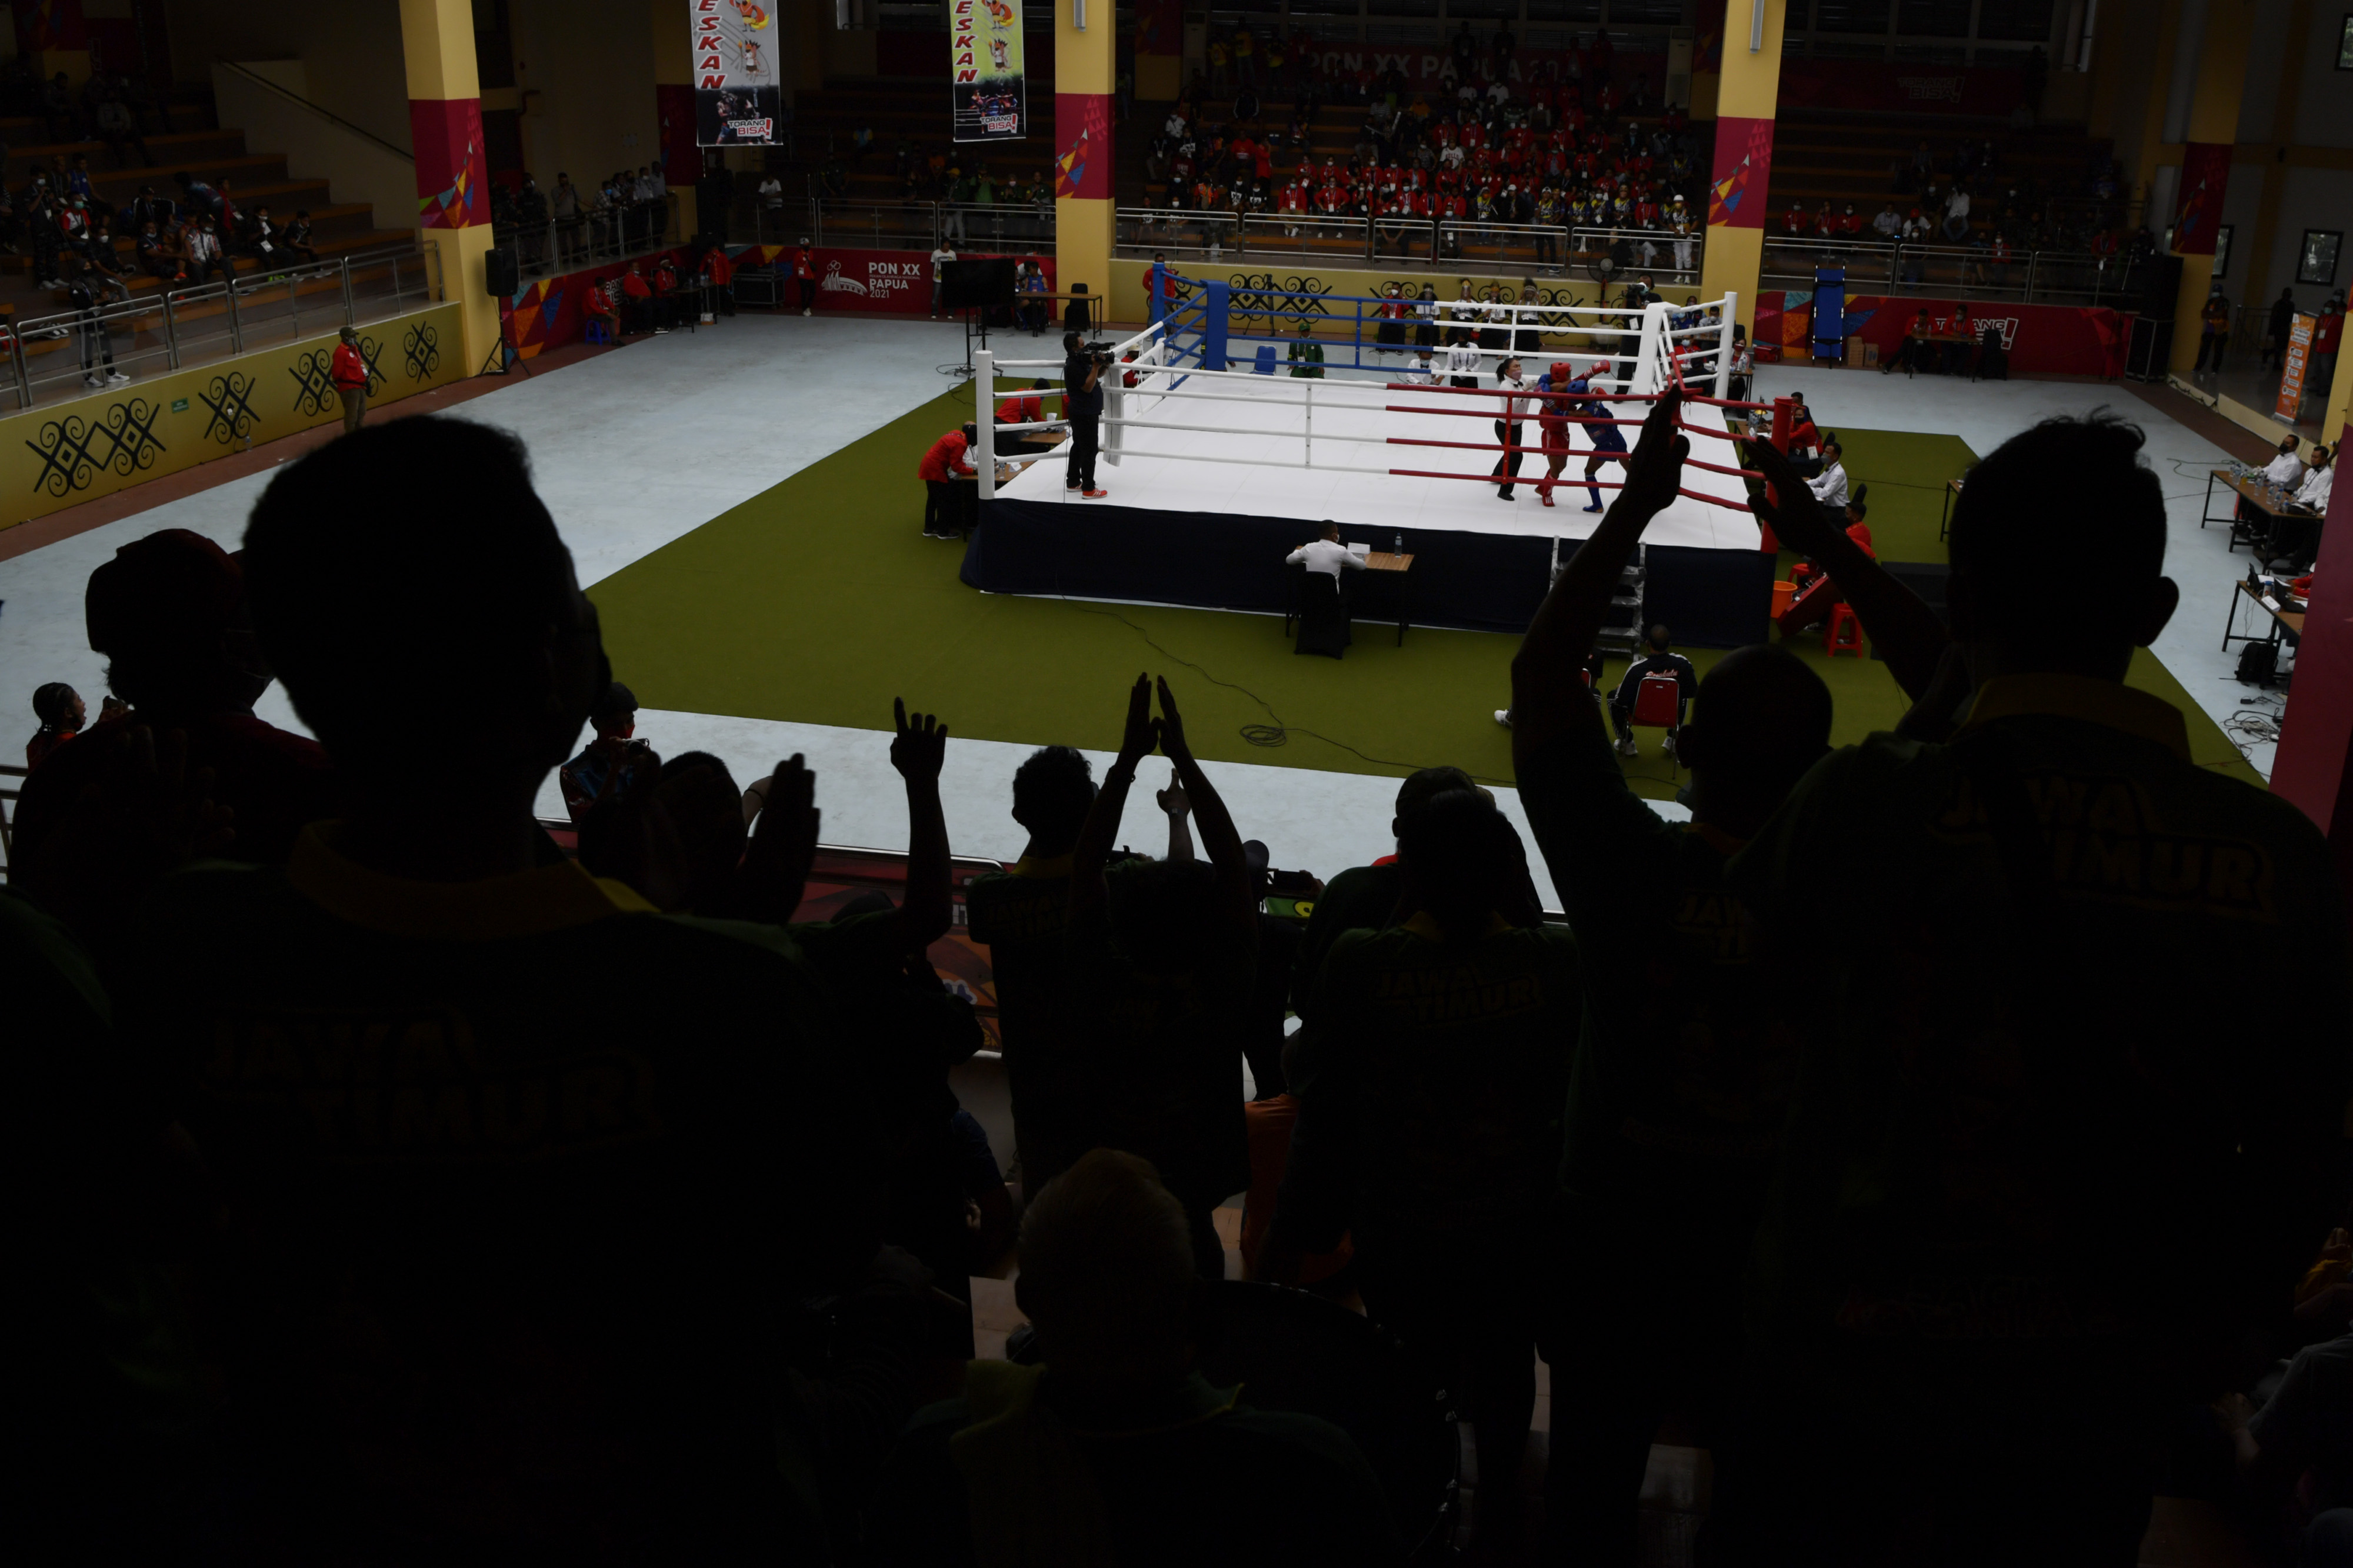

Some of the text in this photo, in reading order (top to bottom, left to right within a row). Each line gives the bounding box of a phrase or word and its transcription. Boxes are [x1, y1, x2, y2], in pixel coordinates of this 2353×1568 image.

[1374, 54, 1411, 78] XX
[1897, 77, 1954, 87] TORANG
[729, 120, 765, 128] TORANG
[981, 116, 1012, 124] TORANG
[868, 262, 921, 276] PON XX
[869, 278, 909, 290] PAPUA
[869, 289, 889, 298] 2021
[1377, 967, 1478, 998] JAWA
[1413, 978, 1532, 1022] TIMUR
[205, 1019, 456, 1082] JAWA
[298, 1069, 634, 1147] TIMUR
